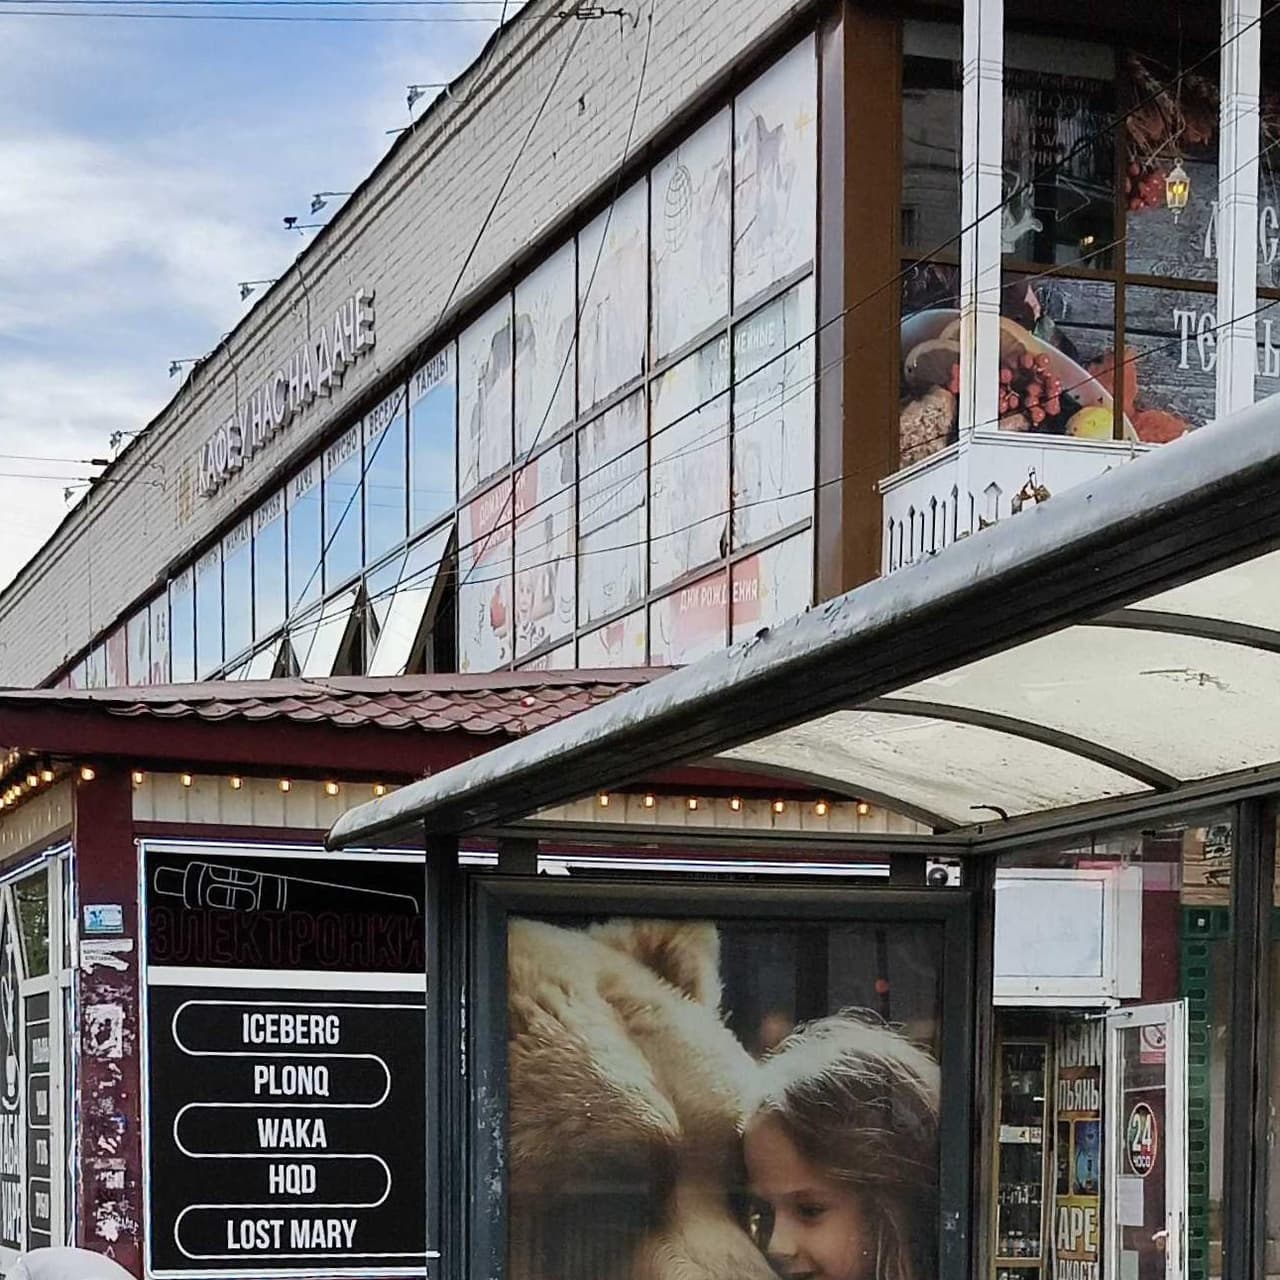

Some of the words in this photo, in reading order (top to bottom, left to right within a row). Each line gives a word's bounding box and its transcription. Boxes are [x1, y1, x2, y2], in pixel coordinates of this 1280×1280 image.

[197, 422, 242, 498] КАФЕ
[250, 370, 292, 448] НАС
[288, 342, 316, 410] НА
[316, 287, 376, 399] ДАЧЕ
[241, 1012, 341, 1046] ICEBERG
[253, 1065, 329, 1097] PLONQ
[257, 1117, 327, 1149] WAKA
[1132, 1113, 1152, 1152] 24
[268, 1164, 317, 1195] HQD
[226, 1221, 286, 1250] LOST
[290, 1219, 357, 1249] MARY
